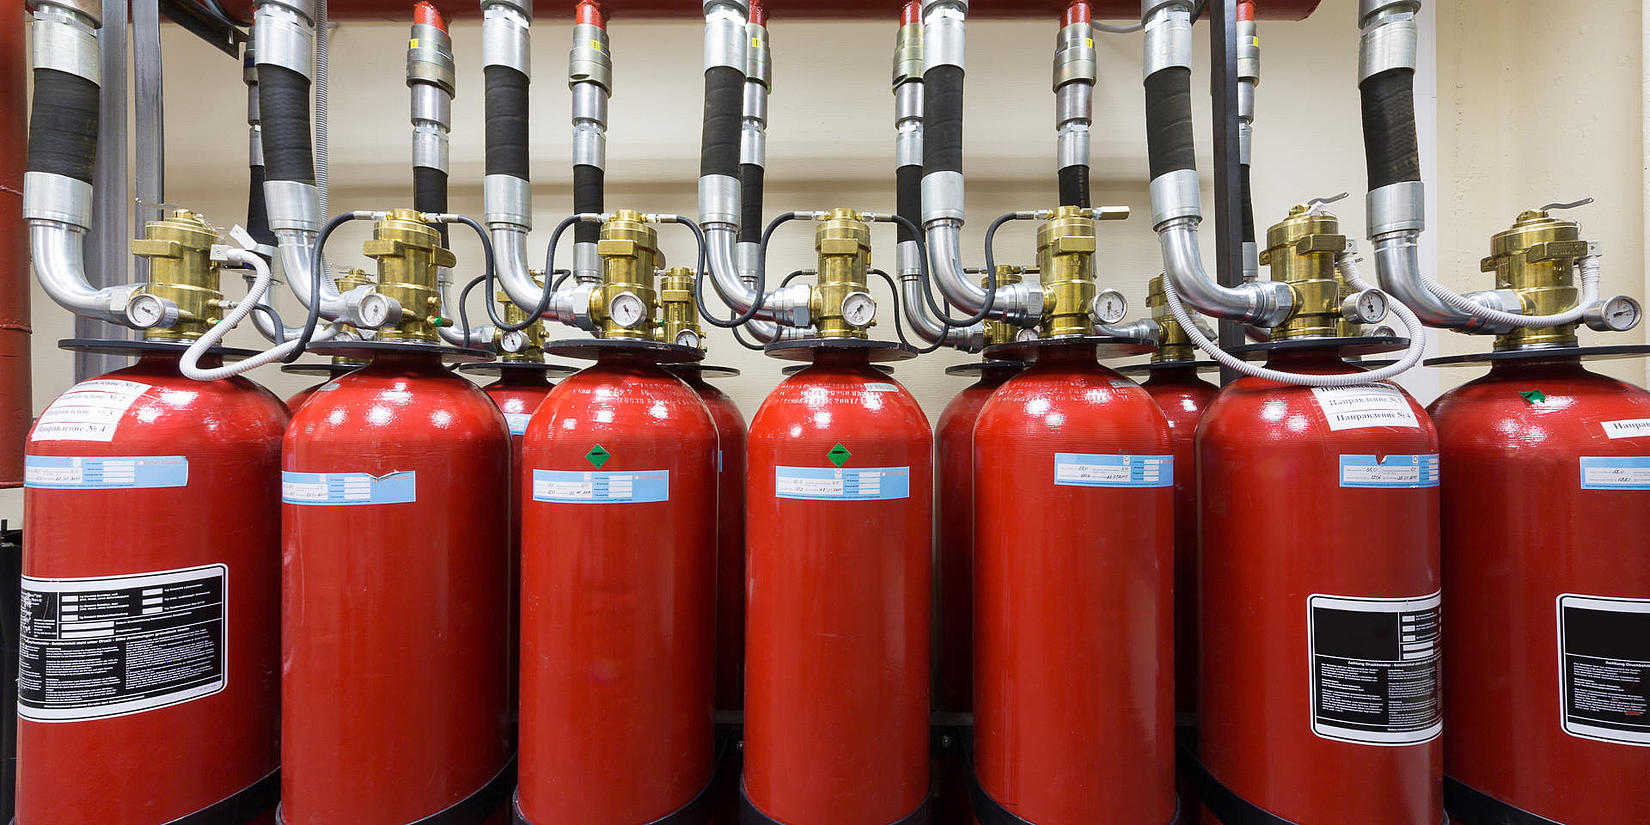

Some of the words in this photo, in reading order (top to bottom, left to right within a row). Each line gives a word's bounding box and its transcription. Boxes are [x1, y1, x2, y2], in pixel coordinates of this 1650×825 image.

[1329, 396, 1387, 406] Направление
[1336, 411, 1396, 421] Направление
[1397, 410, 1406, 418] №
[37, 424, 85, 433] Направление
